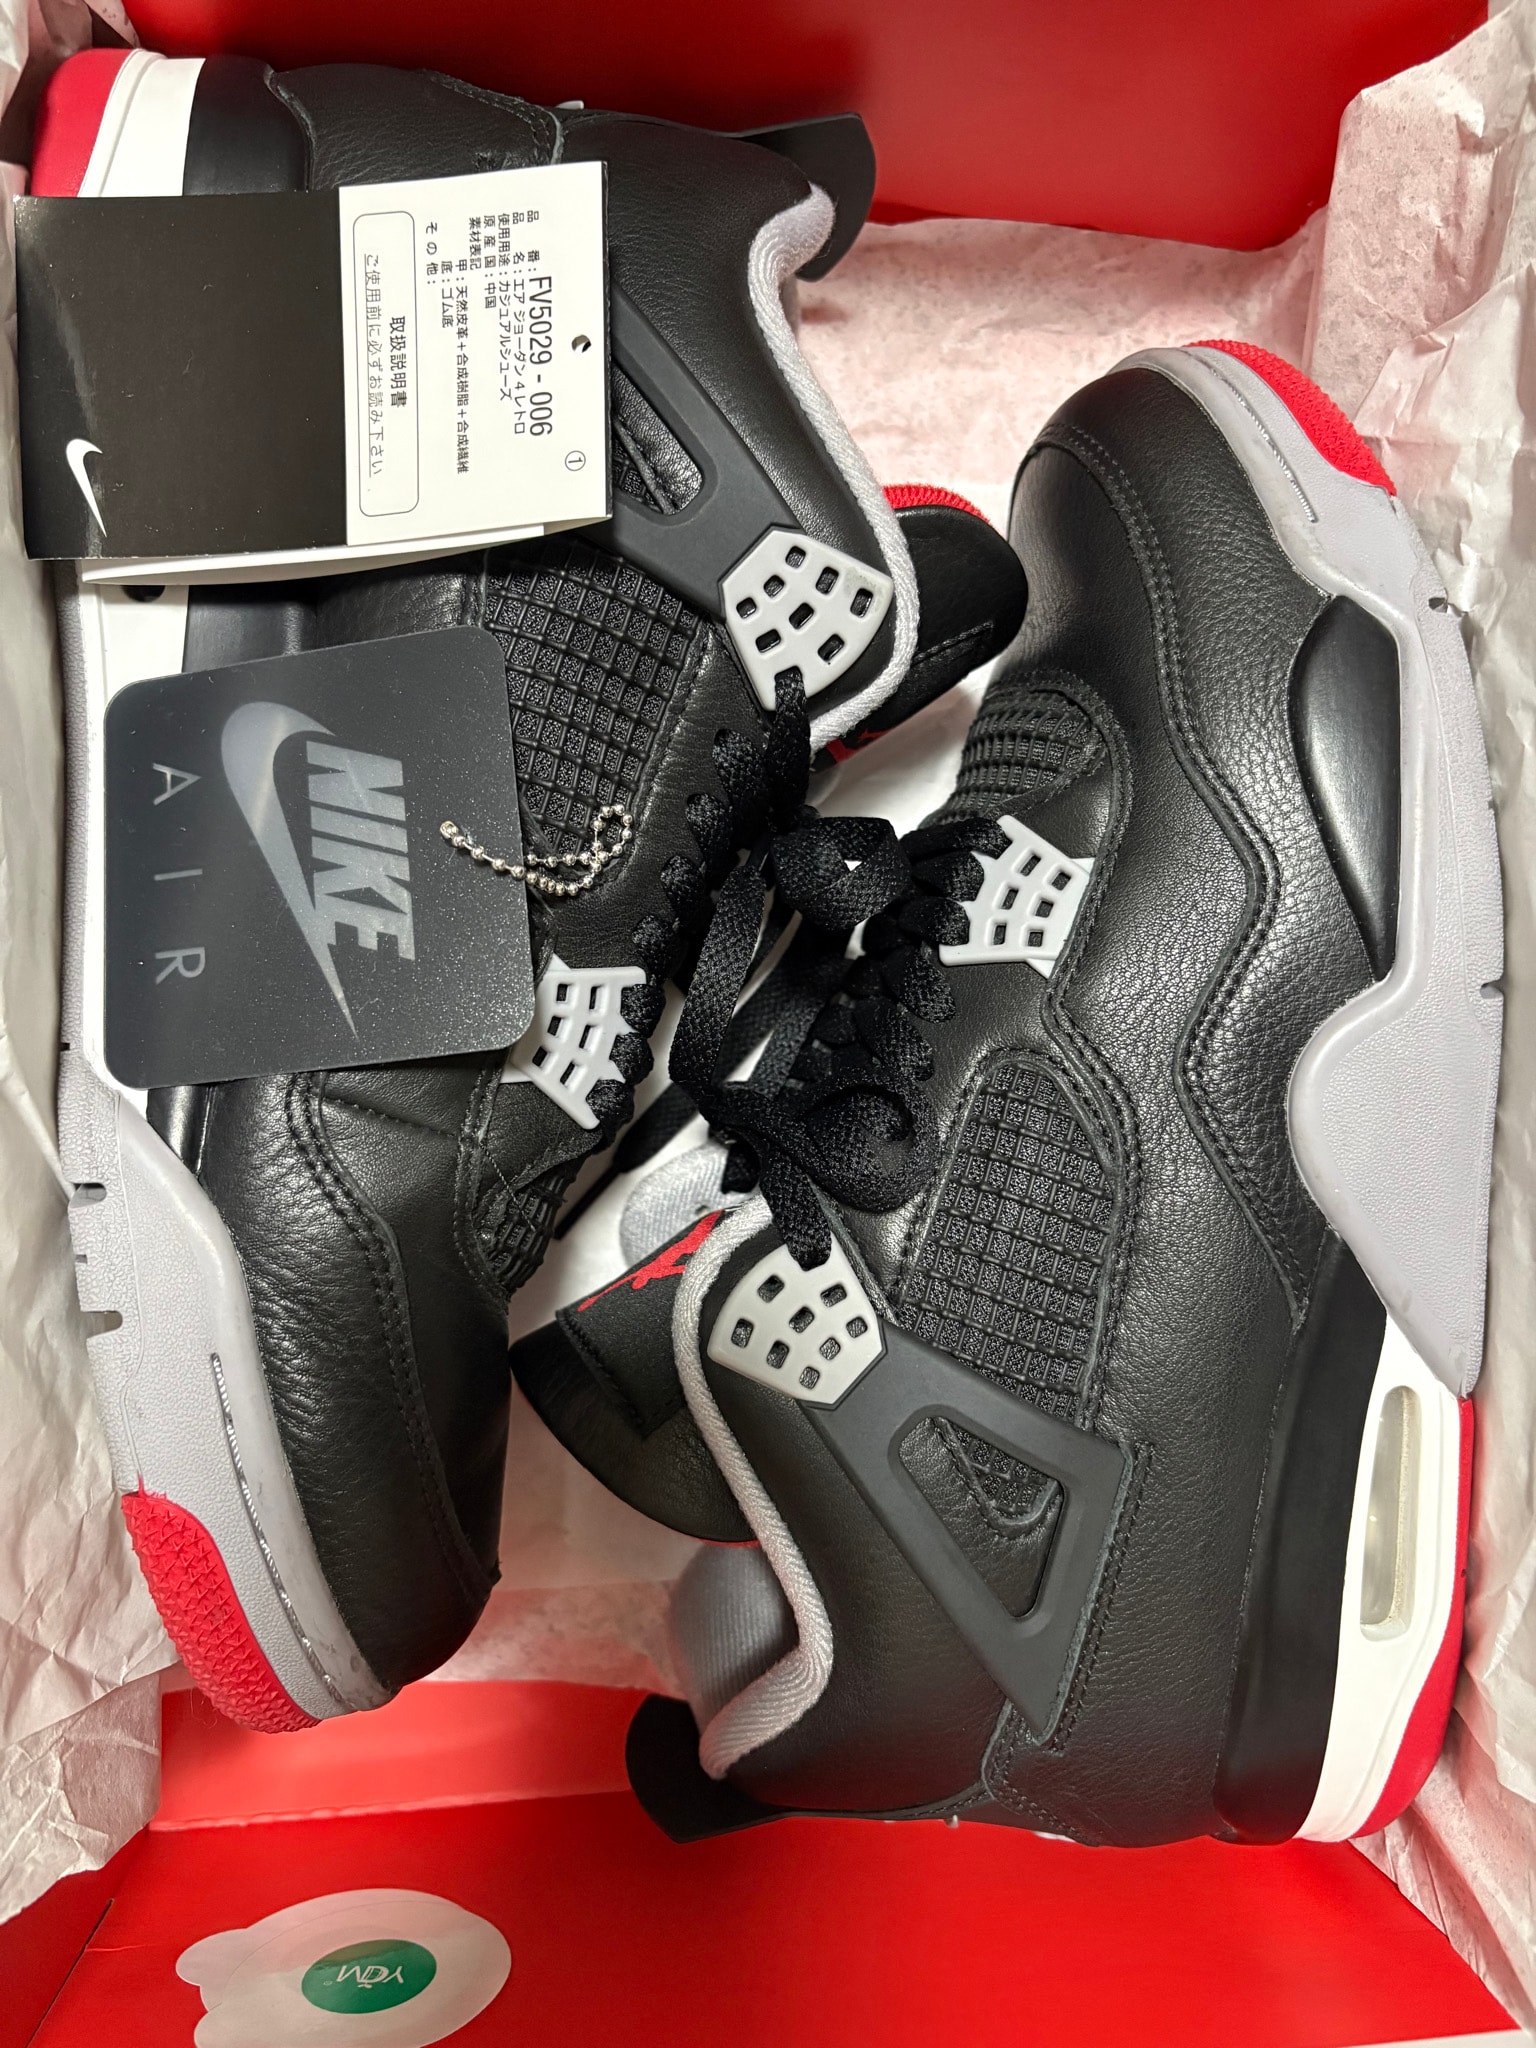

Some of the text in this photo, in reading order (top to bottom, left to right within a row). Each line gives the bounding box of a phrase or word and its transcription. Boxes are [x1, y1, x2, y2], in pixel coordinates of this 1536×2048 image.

[468, 216, 482, 271] 素材表記
[365, 254, 385, 476] ご使用前に必ずお読み下さい
[389, 315, 408, 408] 取扱説明書
[529, 275, 553, 365] FV5029
[529, 391, 553, 436] 006
[306, 741, 415, 961] NIKE
